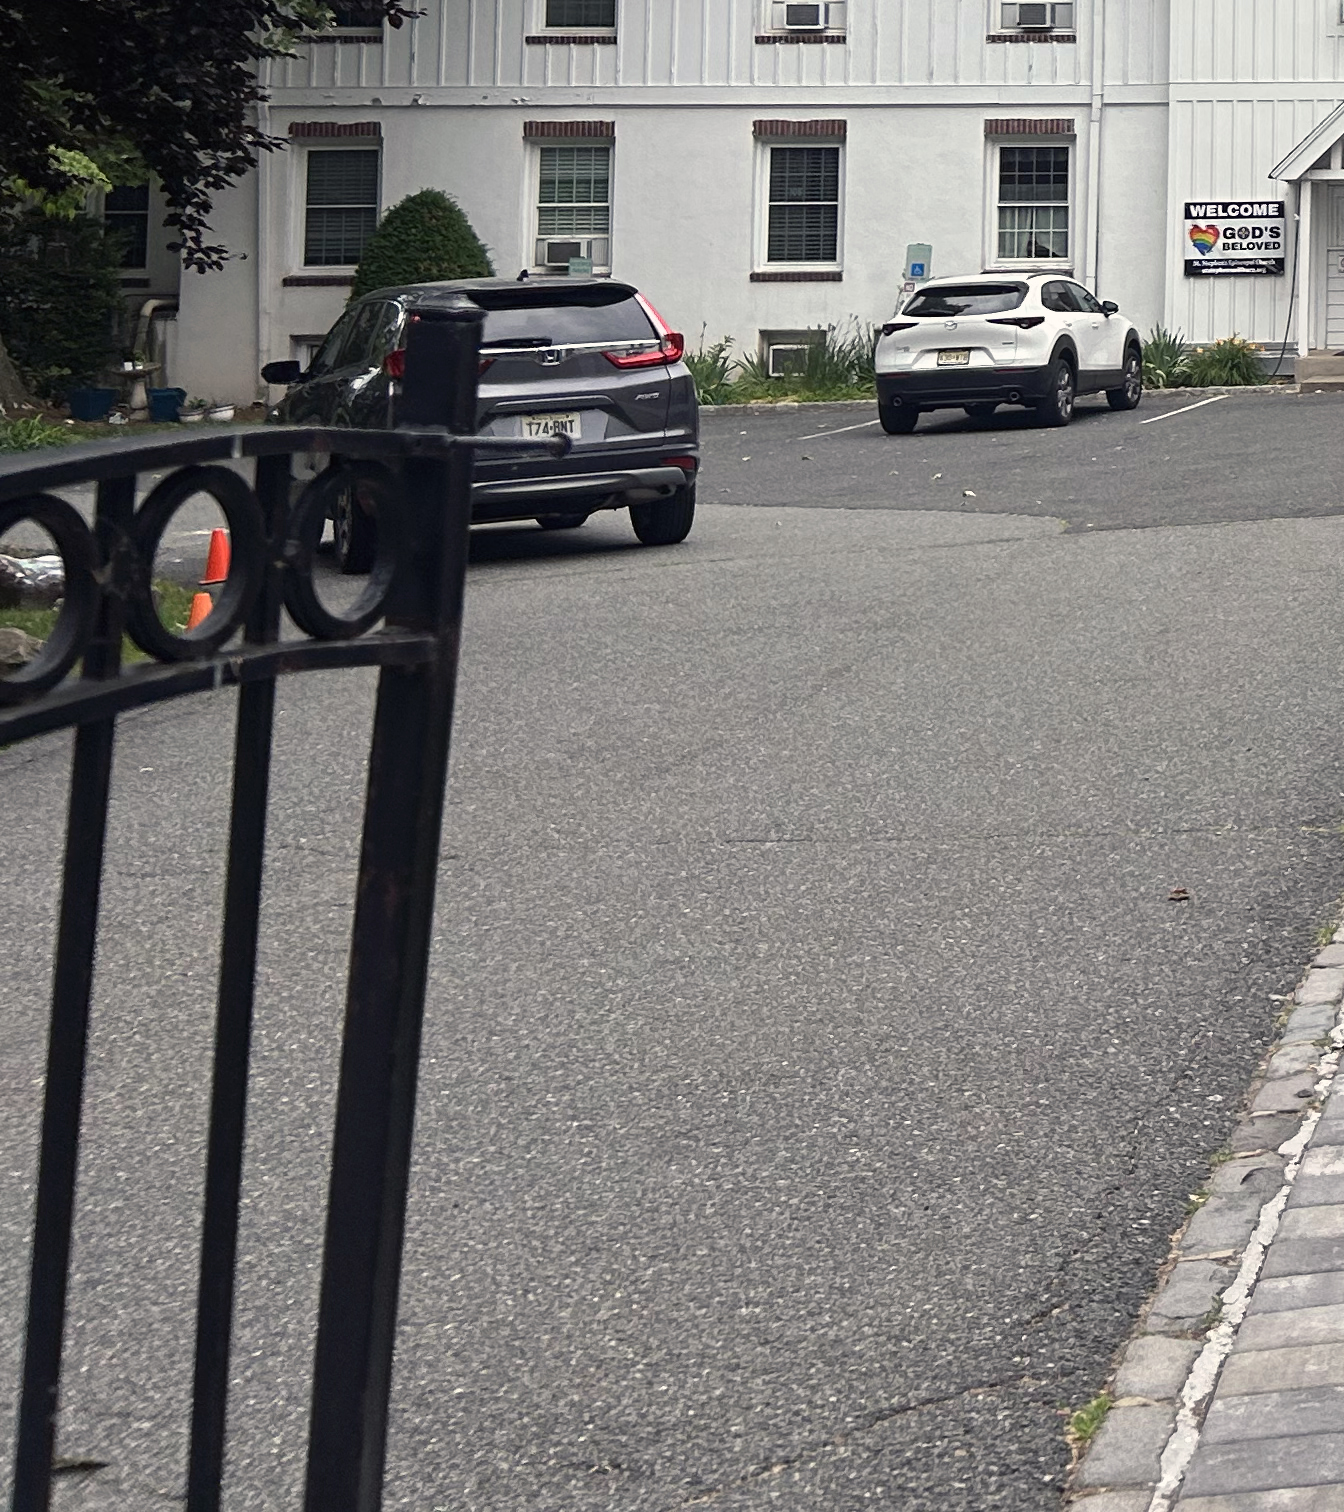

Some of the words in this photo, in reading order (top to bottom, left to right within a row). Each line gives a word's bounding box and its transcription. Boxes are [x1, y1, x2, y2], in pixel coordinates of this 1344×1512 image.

[1189, 203, 1280, 217] WELCOME
[1222, 226, 1281, 240] GOD'S
[1222, 241, 1281, 251] BELOVED
